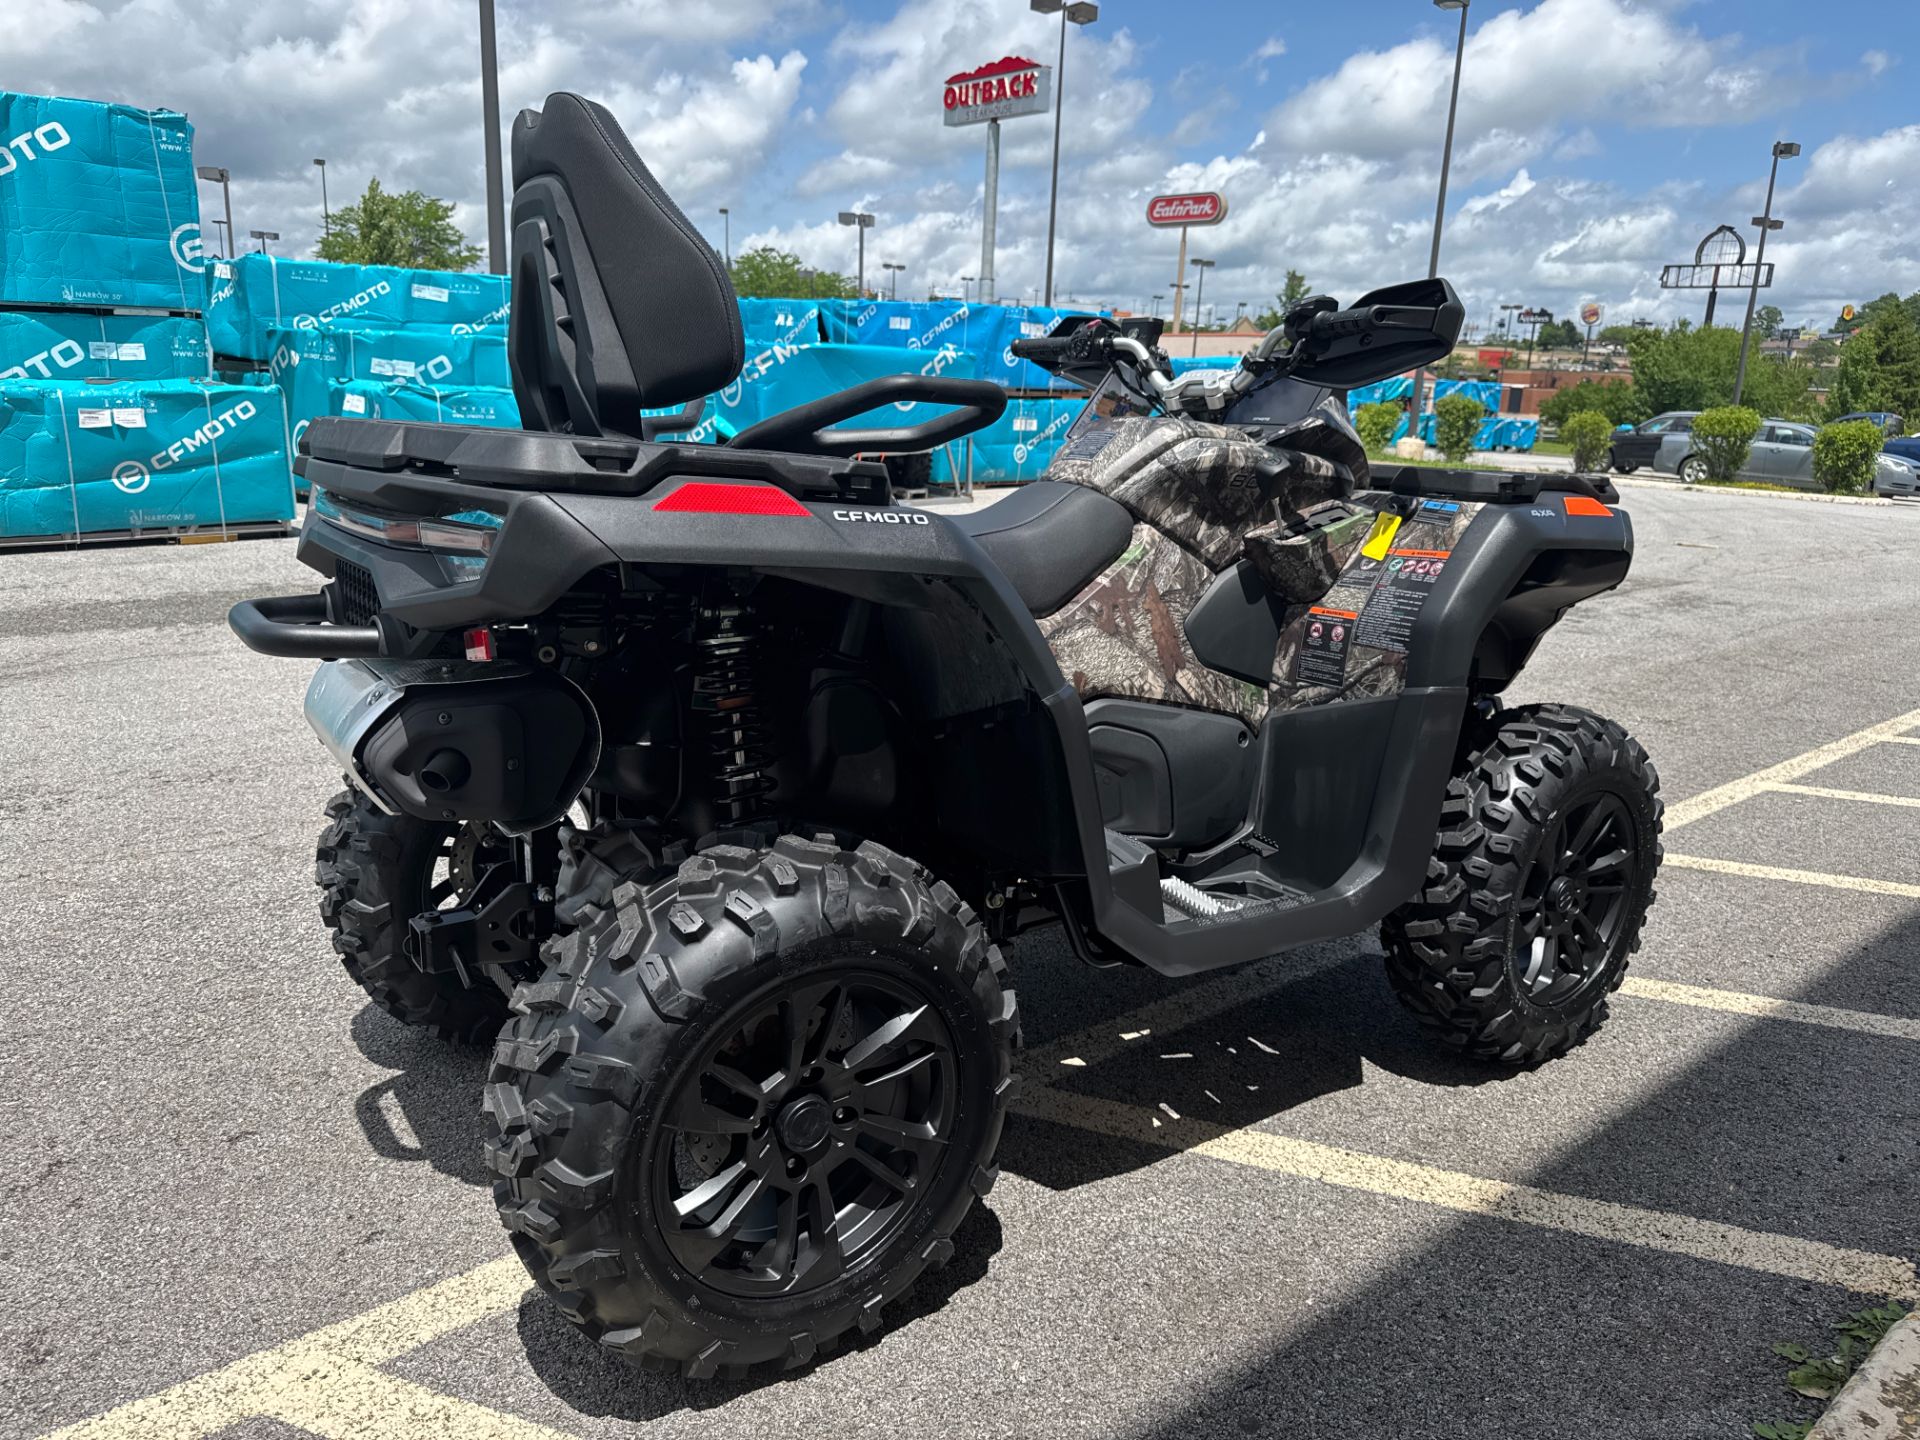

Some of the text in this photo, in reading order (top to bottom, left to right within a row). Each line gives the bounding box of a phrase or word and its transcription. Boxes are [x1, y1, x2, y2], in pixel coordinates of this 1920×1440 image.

[944, 71, 1039, 111] OUTBACK
[75, 290, 109, 299] NARROW
[319, 280, 391, 323] CFMOTO
[922, 305, 969, 346] CFMOTO
[742, 344, 811, 383] CFM
[150, 400, 257, 471] CFMOTO
[1026, 412, 1070, 451] CFMOTO
[833, 510, 929, 525] CFMOTO
